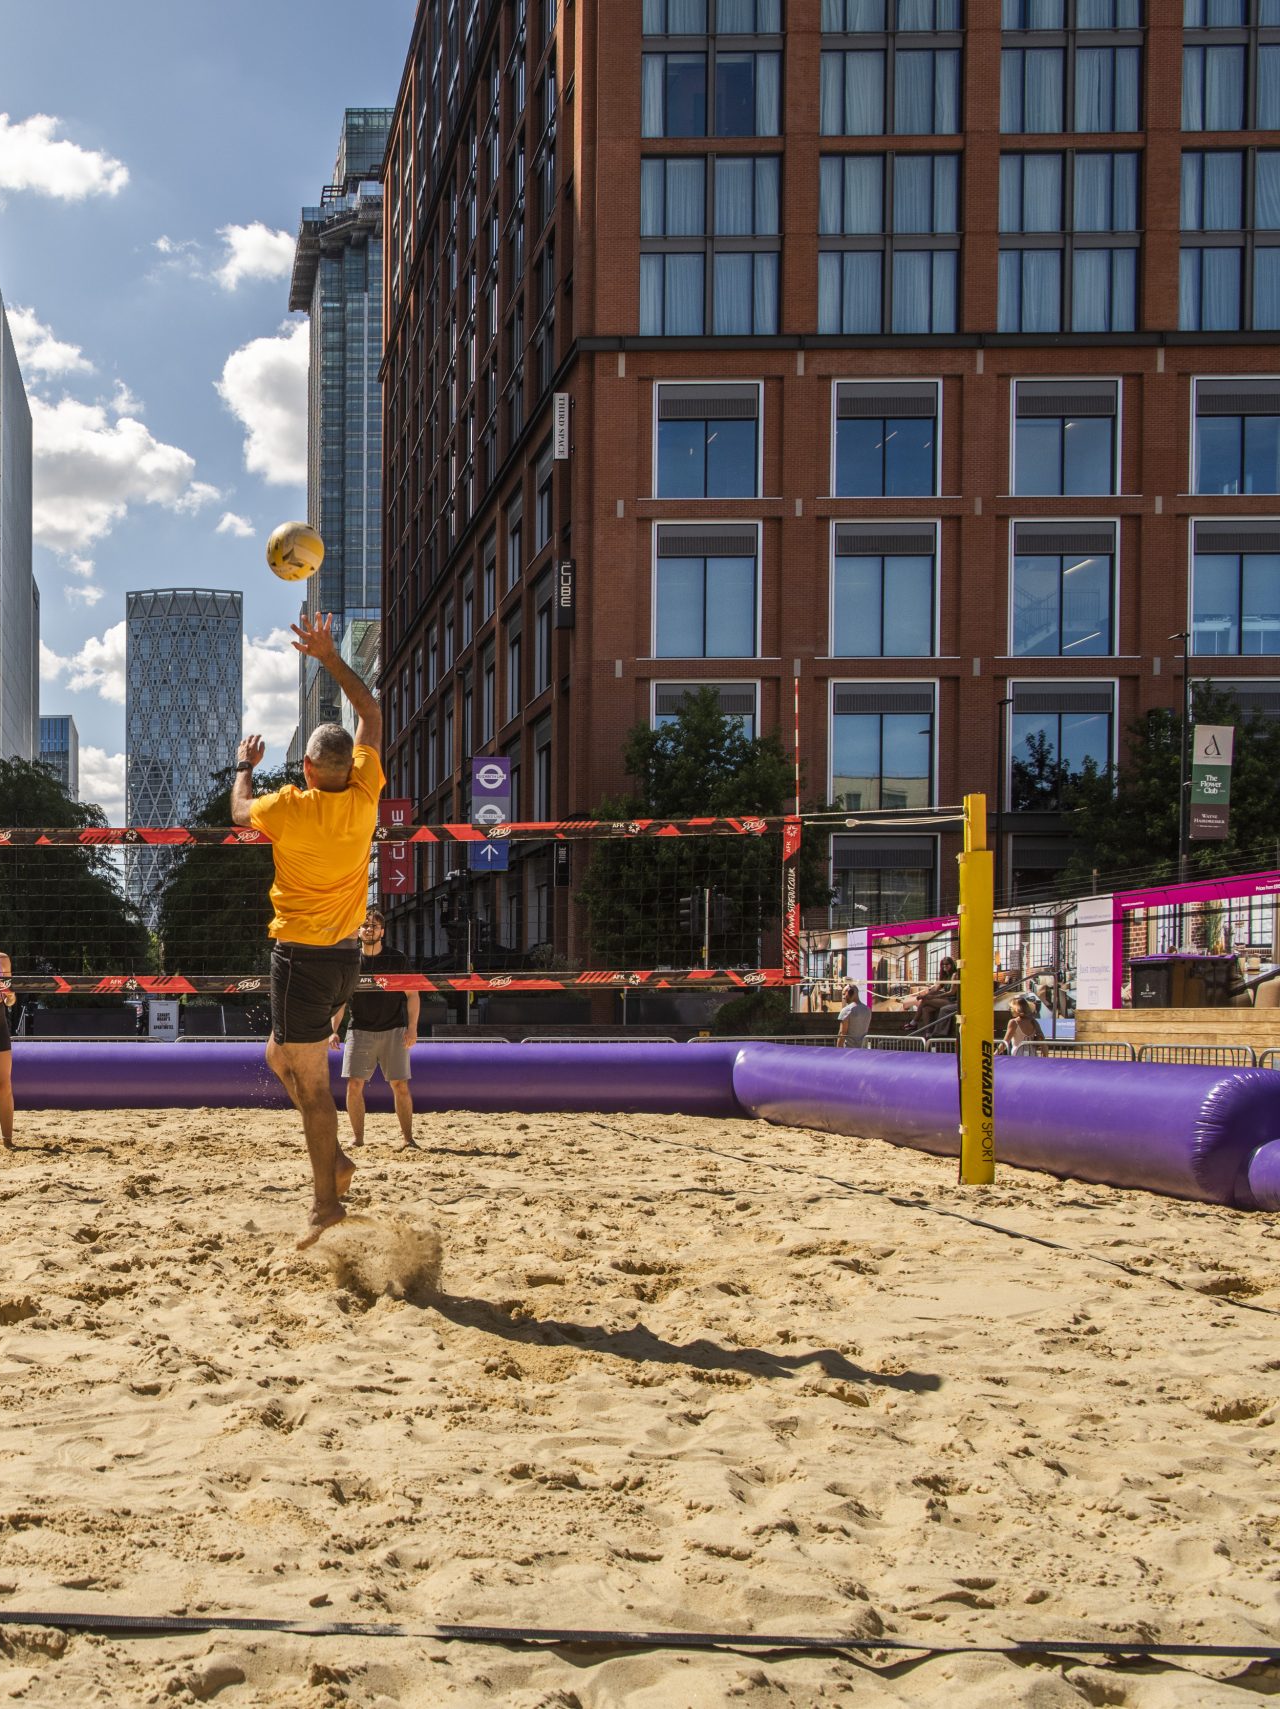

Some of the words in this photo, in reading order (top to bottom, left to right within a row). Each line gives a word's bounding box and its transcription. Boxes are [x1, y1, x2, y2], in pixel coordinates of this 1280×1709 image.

[560, 565, 572, 607] CUBE
[1200, 781, 1222, 789] Flower
[1205, 774, 1218, 782] The
[1203, 787, 1219, 795] Club
[981, 1040, 993, 1118] ERHARD
[981, 1122, 993, 1162] SPORT
